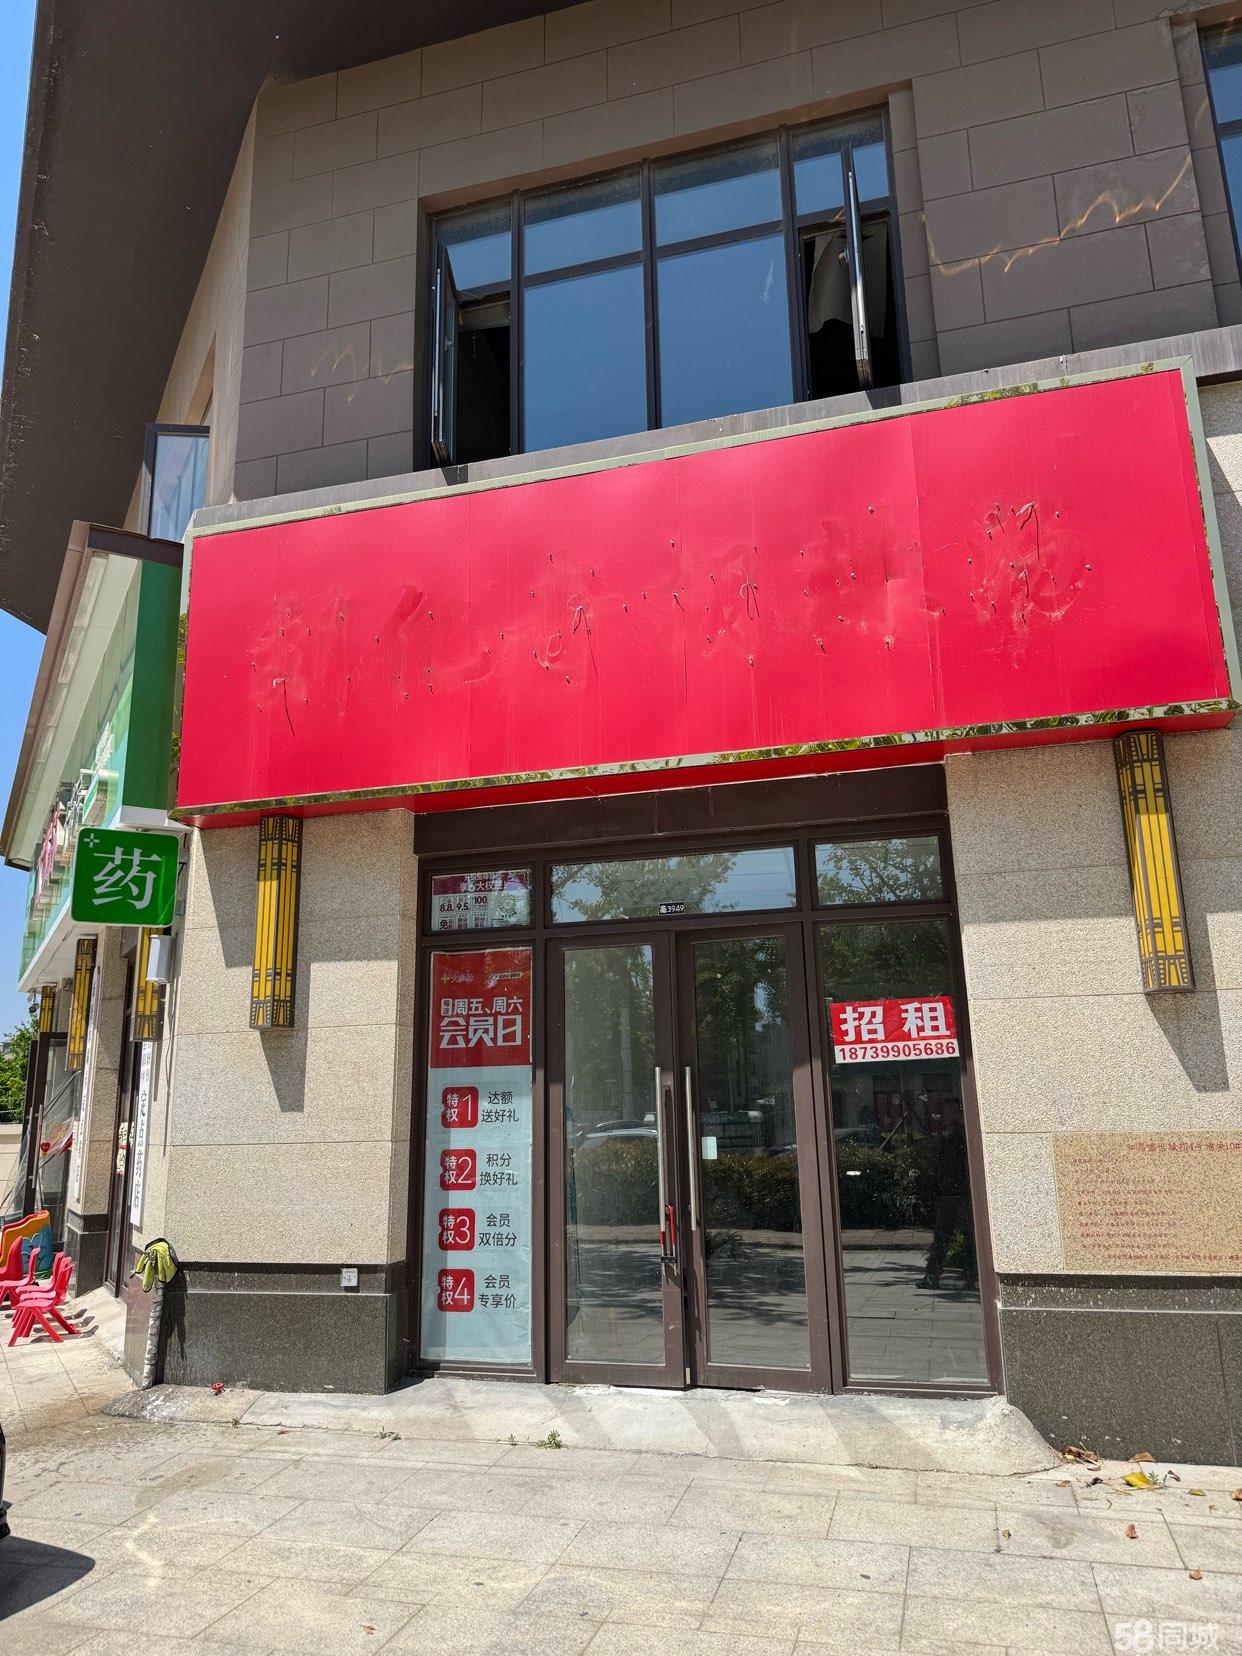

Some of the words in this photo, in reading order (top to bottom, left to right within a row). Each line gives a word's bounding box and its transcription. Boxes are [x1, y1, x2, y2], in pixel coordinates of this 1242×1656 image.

[92, 846, 161, 909] 药
[840, 1002, 951, 1042] 招租
[440, 1014, 522, 1049] 会员日
[839, 1041, 956, 1061] 18739905686
[487, 1090, 513, 1105] 达额
[481, 1108, 520, 1123] 送好礼
[486, 1152, 512, 1168] 积分
[479, 1170, 518, 1186] 换好礼
[486, 1212, 511, 1228] 会员
[478, 1231, 518, 1247] 双倍分
[484, 1274, 511, 1290] 会员
[478, 1292, 517, 1309] 专享价
